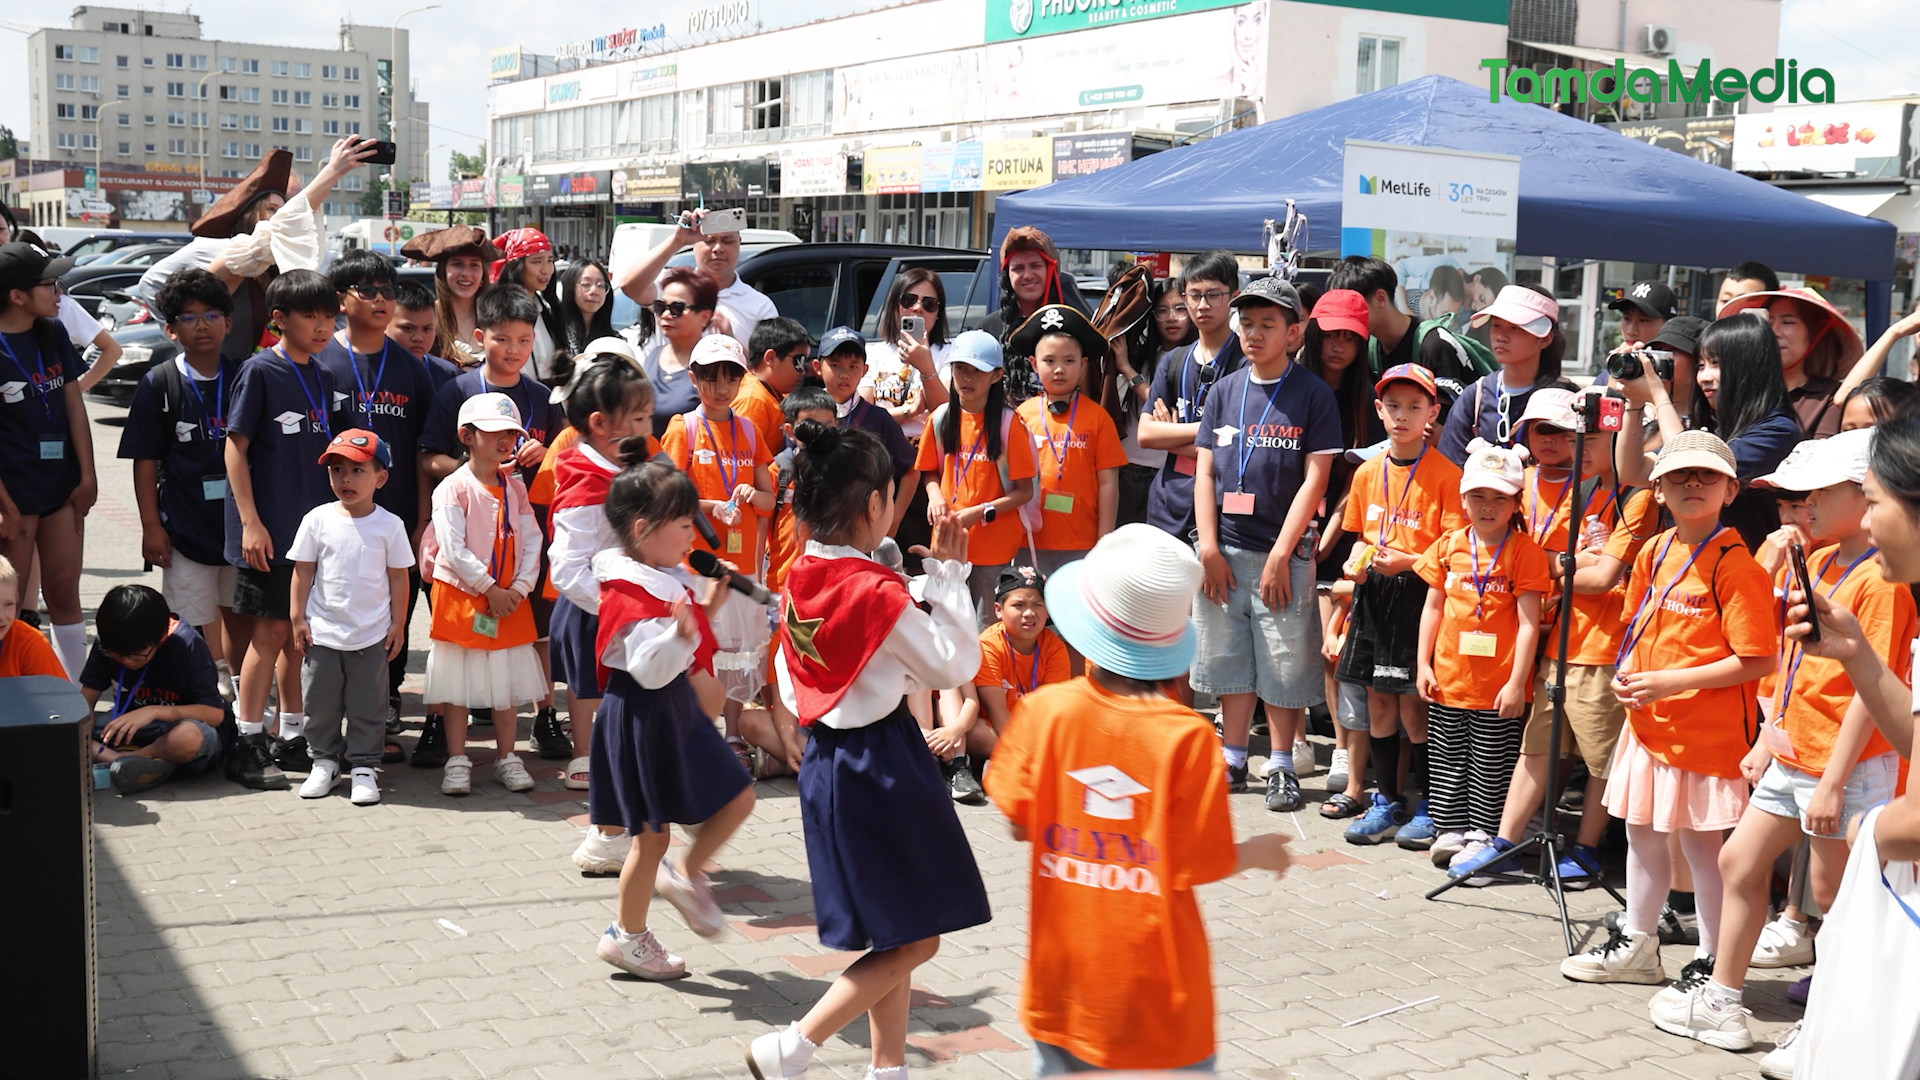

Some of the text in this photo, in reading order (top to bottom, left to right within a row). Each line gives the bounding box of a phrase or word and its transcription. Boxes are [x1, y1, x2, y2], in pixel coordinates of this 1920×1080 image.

[1088, 1, 1177, 23] BEAUTY & COSMETIC
[490, 52, 518, 73] SANGU
[549, 80, 581, 104] SANGU
[988, 157, 1044, 175] FORTUNA
[98, 176, 153, 185] ESTAURANT
[164, 180, 219, 189] CONVENION
[1381, 179, 1431, 197] MetLife
[1246, 436, 1302, 451] SCHOOL
[721, 458, 756, 467] SCOOL
[1462, 581, 1508, 593] SCOOL
[1470, 644, 1488, 653] ZEUS
